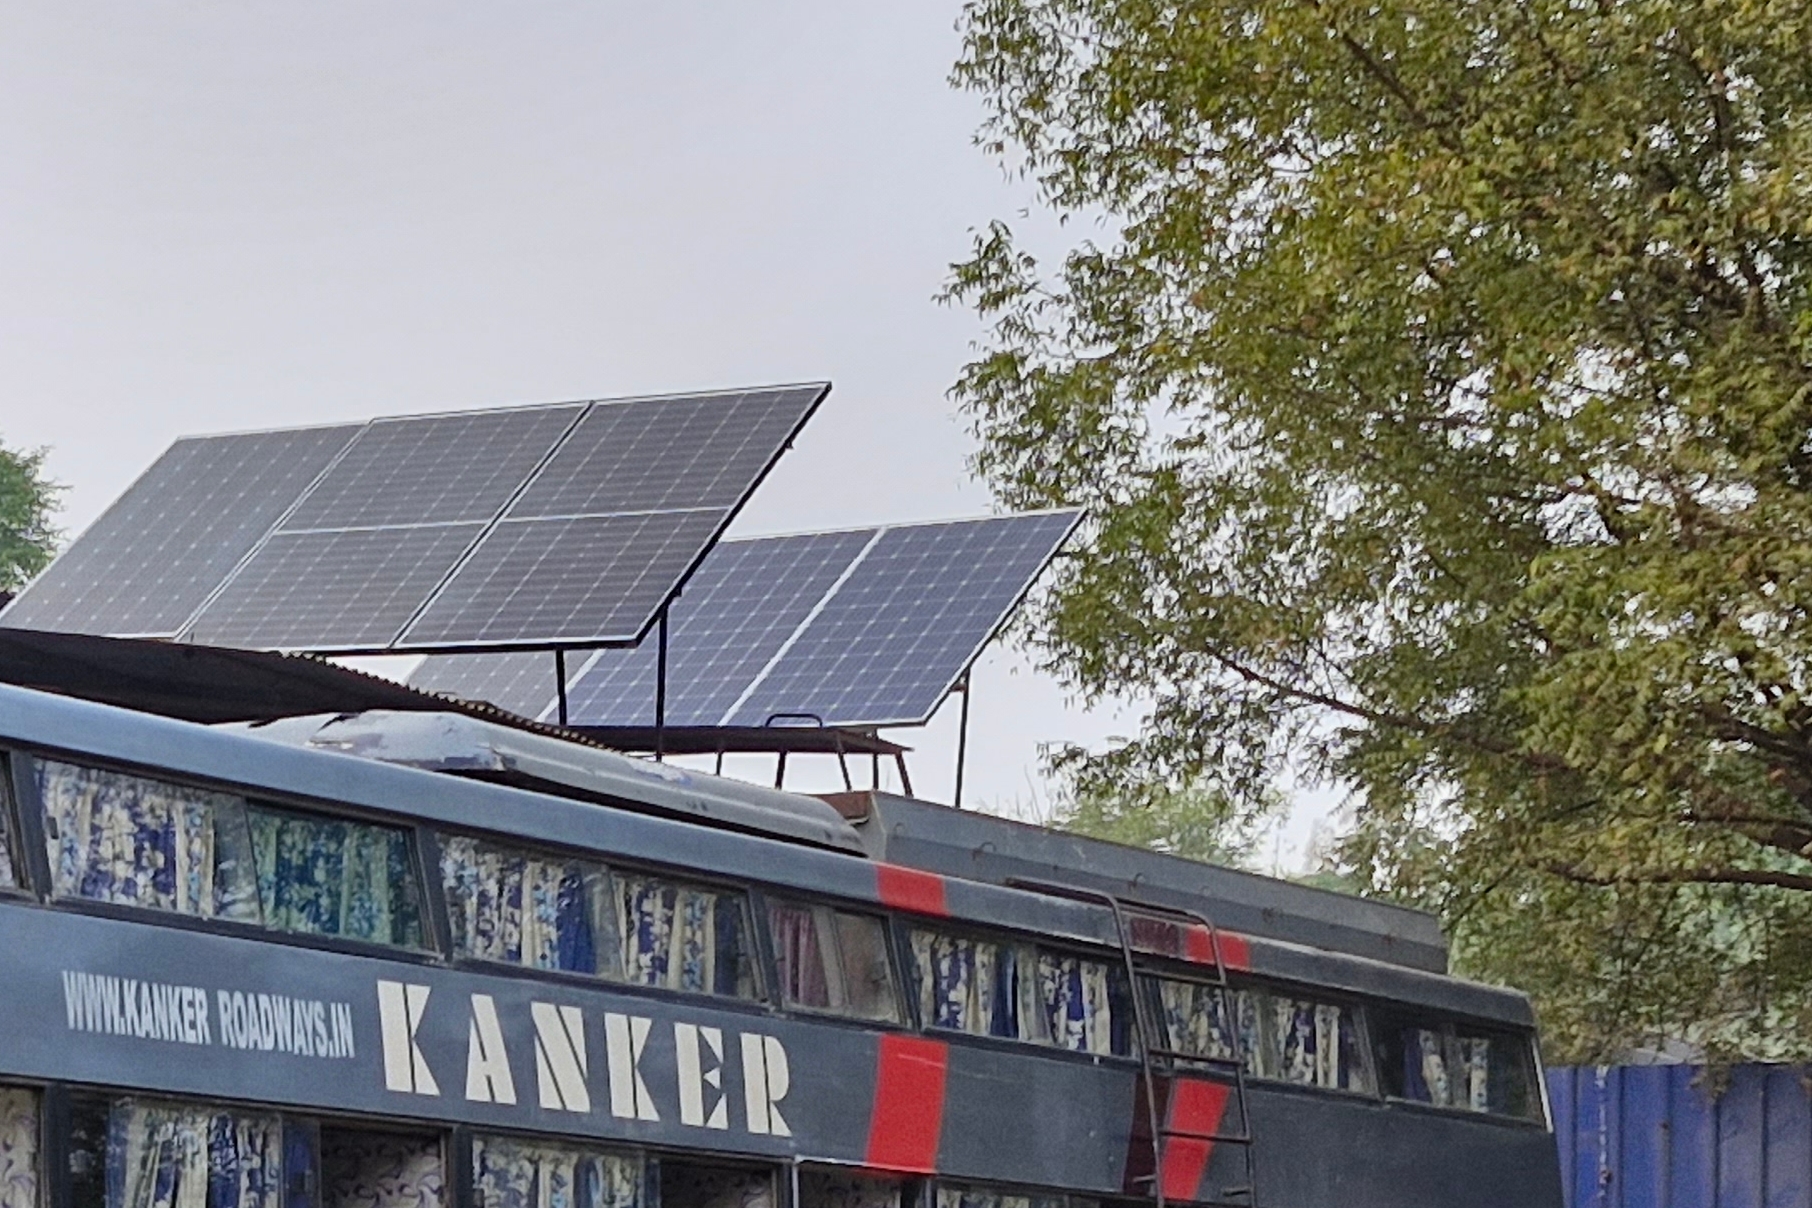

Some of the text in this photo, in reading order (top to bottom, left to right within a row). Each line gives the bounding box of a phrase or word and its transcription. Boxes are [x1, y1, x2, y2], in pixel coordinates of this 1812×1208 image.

[62, 970, 355, 1058] WWW.KANKER ROADWAYS.IN
[377, 980, 792, 1137] KANKER
